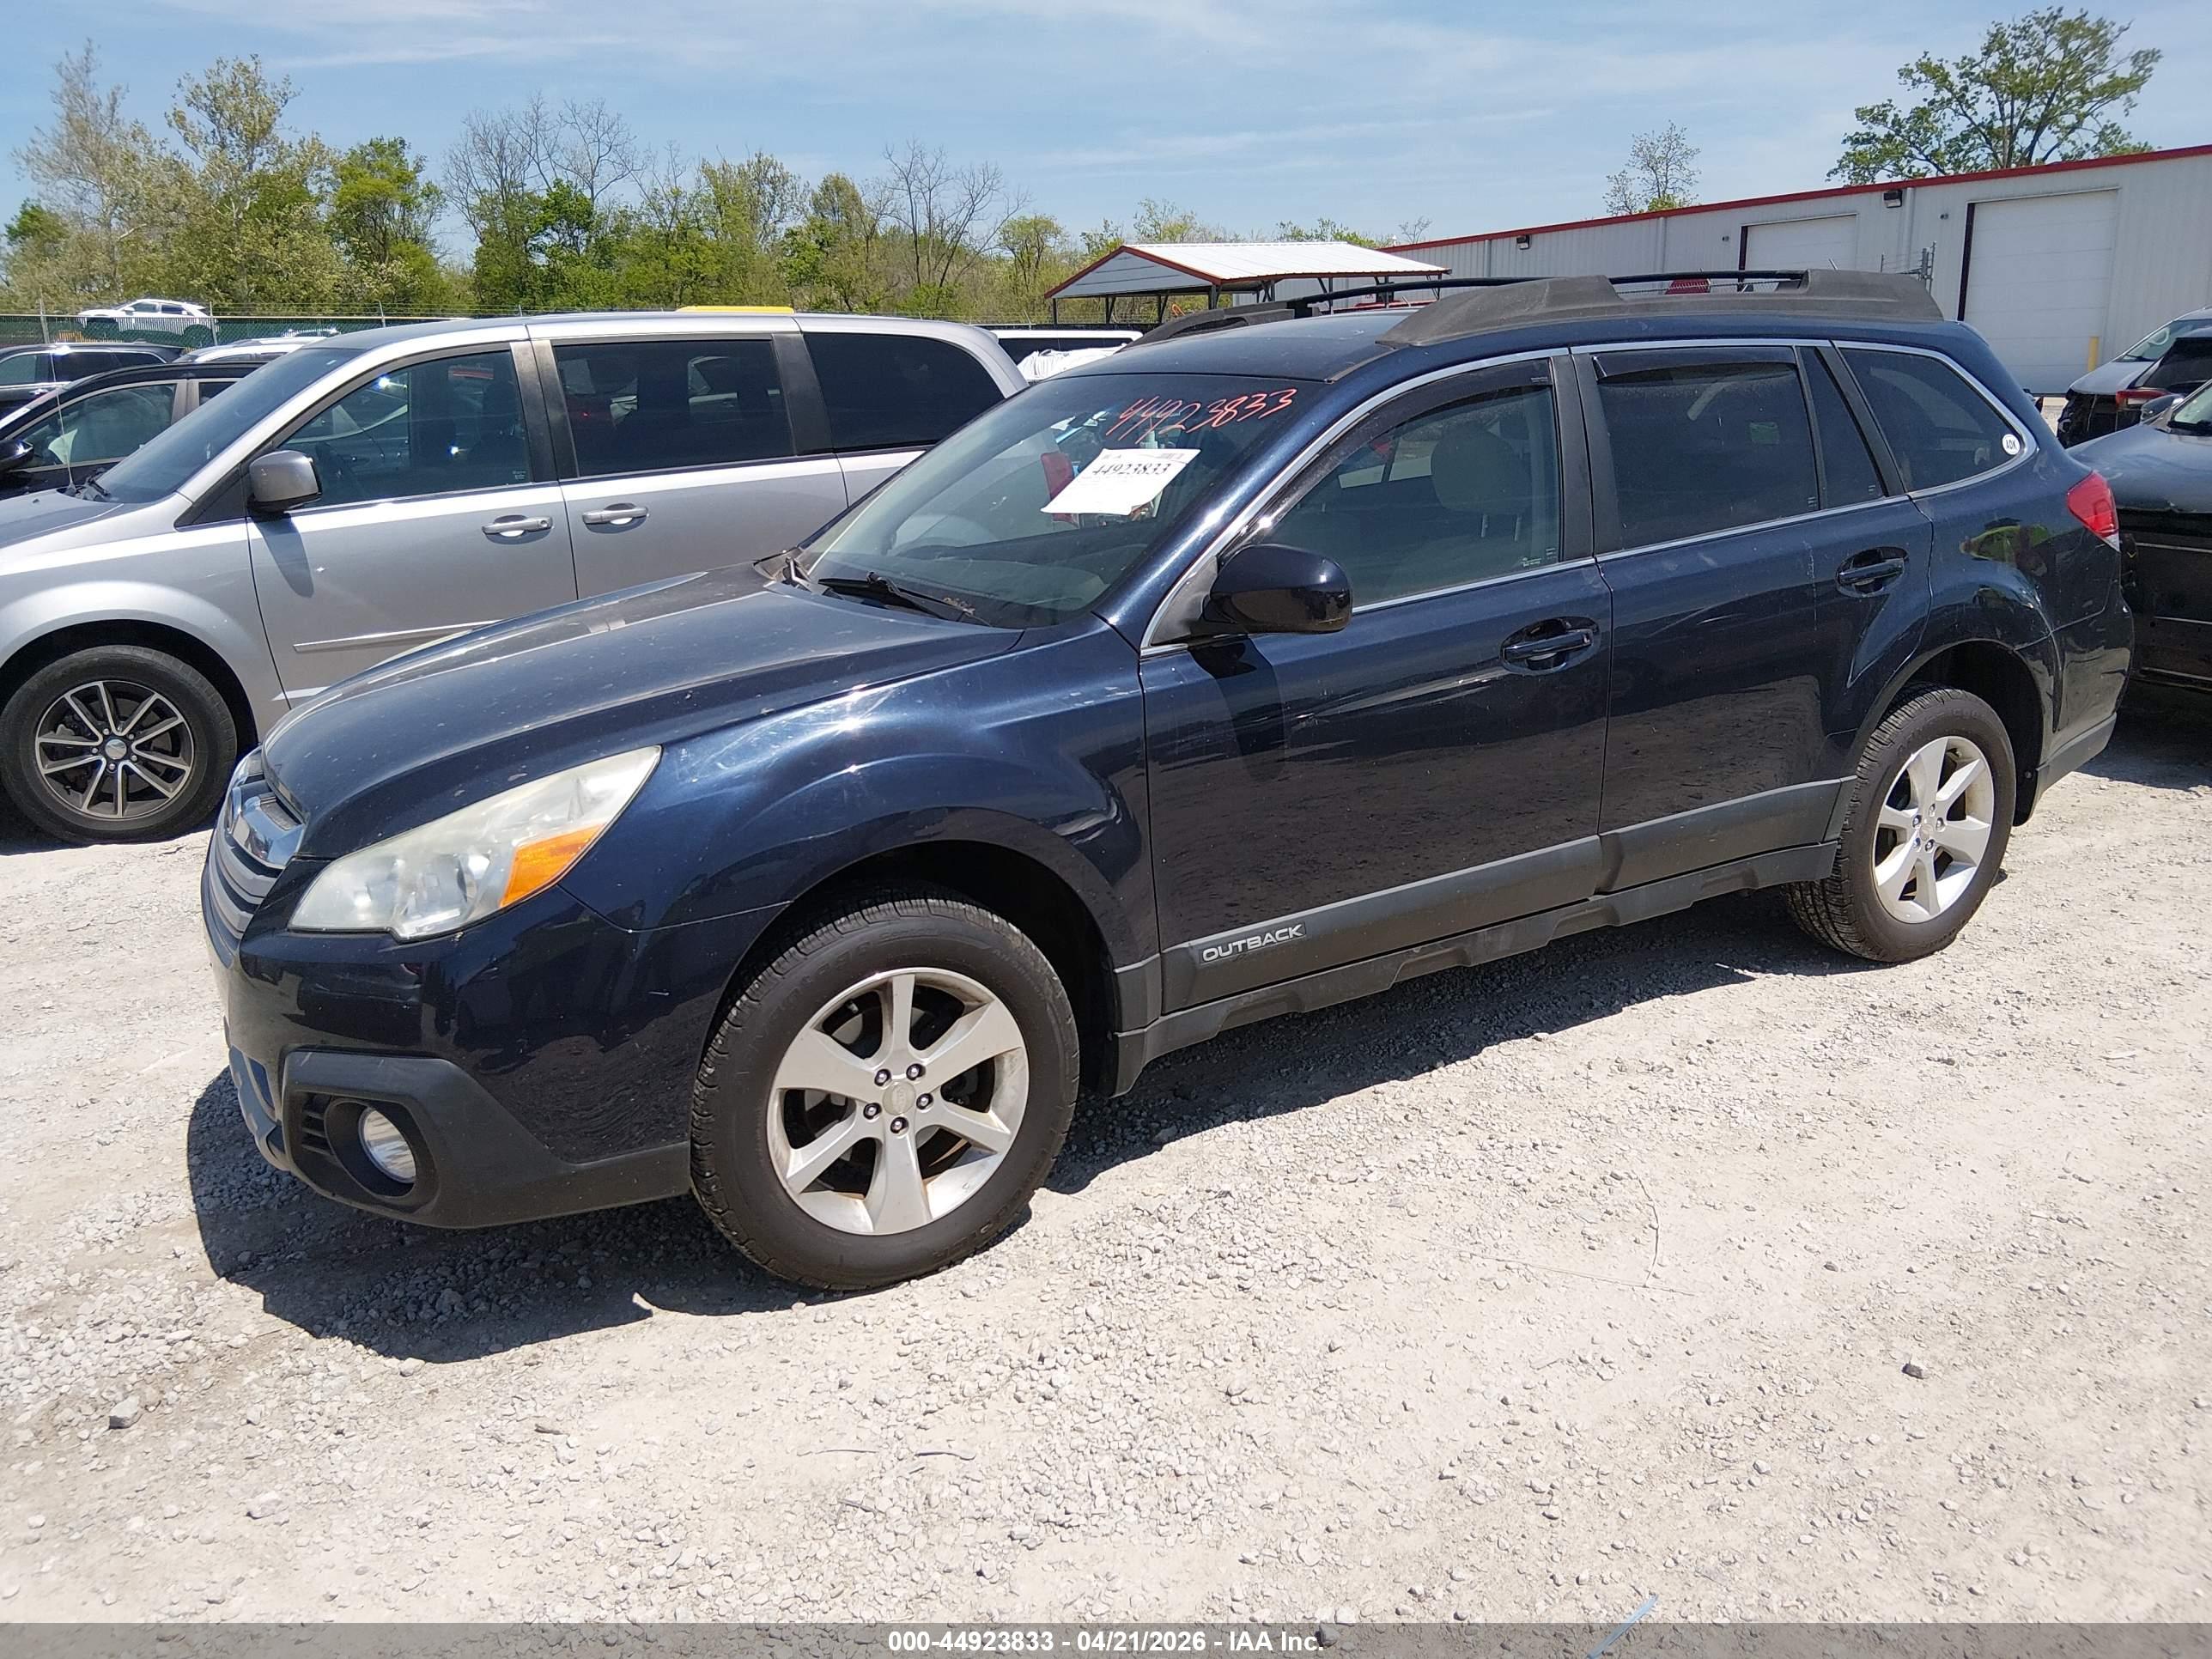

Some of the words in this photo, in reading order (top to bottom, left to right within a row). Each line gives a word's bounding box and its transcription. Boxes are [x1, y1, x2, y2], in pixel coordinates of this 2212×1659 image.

[1105, 388, 1297, 445] 44923833
[1092, 463, 1171, 476] 44923833
[1202, 924, 1304, 962] OUTBACK
